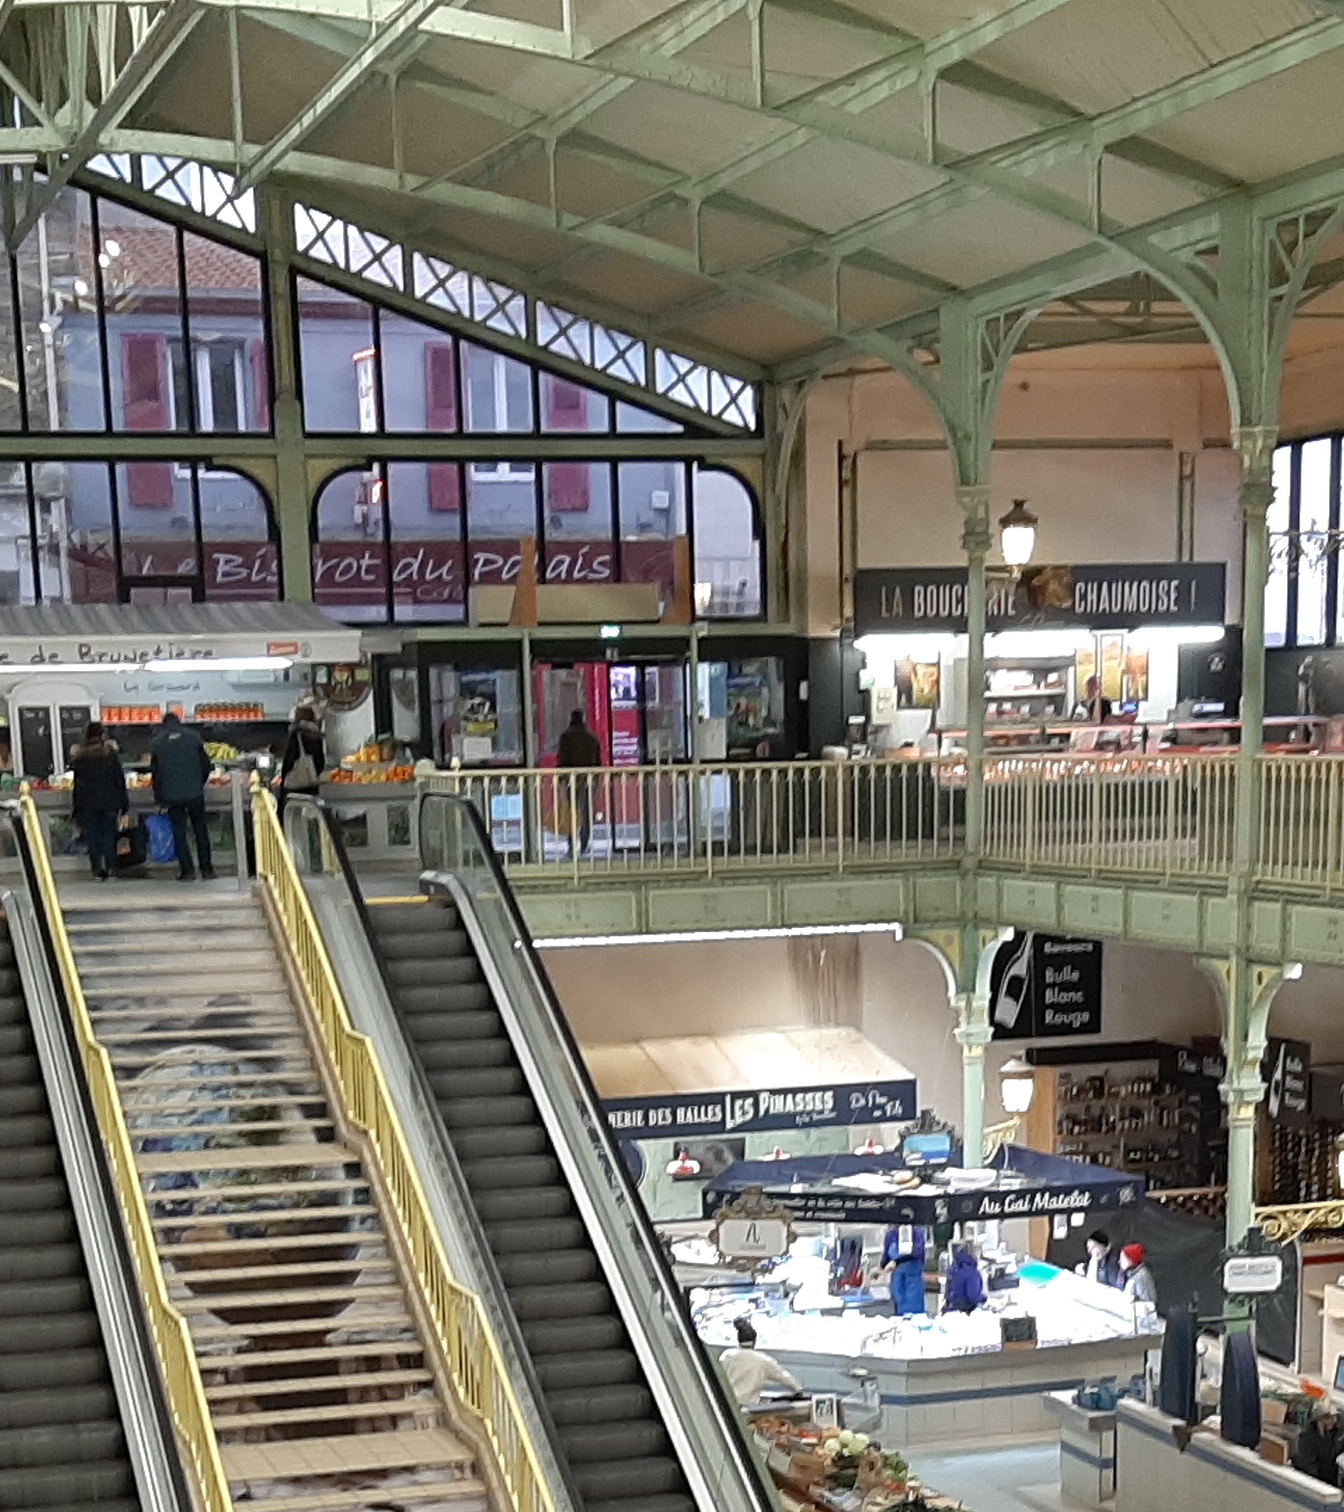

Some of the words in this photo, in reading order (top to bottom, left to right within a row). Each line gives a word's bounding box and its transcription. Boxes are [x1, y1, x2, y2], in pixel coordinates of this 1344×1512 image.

[214, 550, 383, 583] Bisrot
[394, 548, 452, 582] du
[473, 551, 611, 583] Paais
[879, 586, 903, 619] LA
[1074, 579, 1179, 615] CHAUMOISE
[30, 645, 63, 665] de
[648, 1105, 672, 1126] DES
[677, 1103, 723, 1125] HALLES
[725, 1094, 755, 1131] LES
[979, 1197, 1002, 1216] Au
[1033, 1190, 1092, 1211] Matelot
